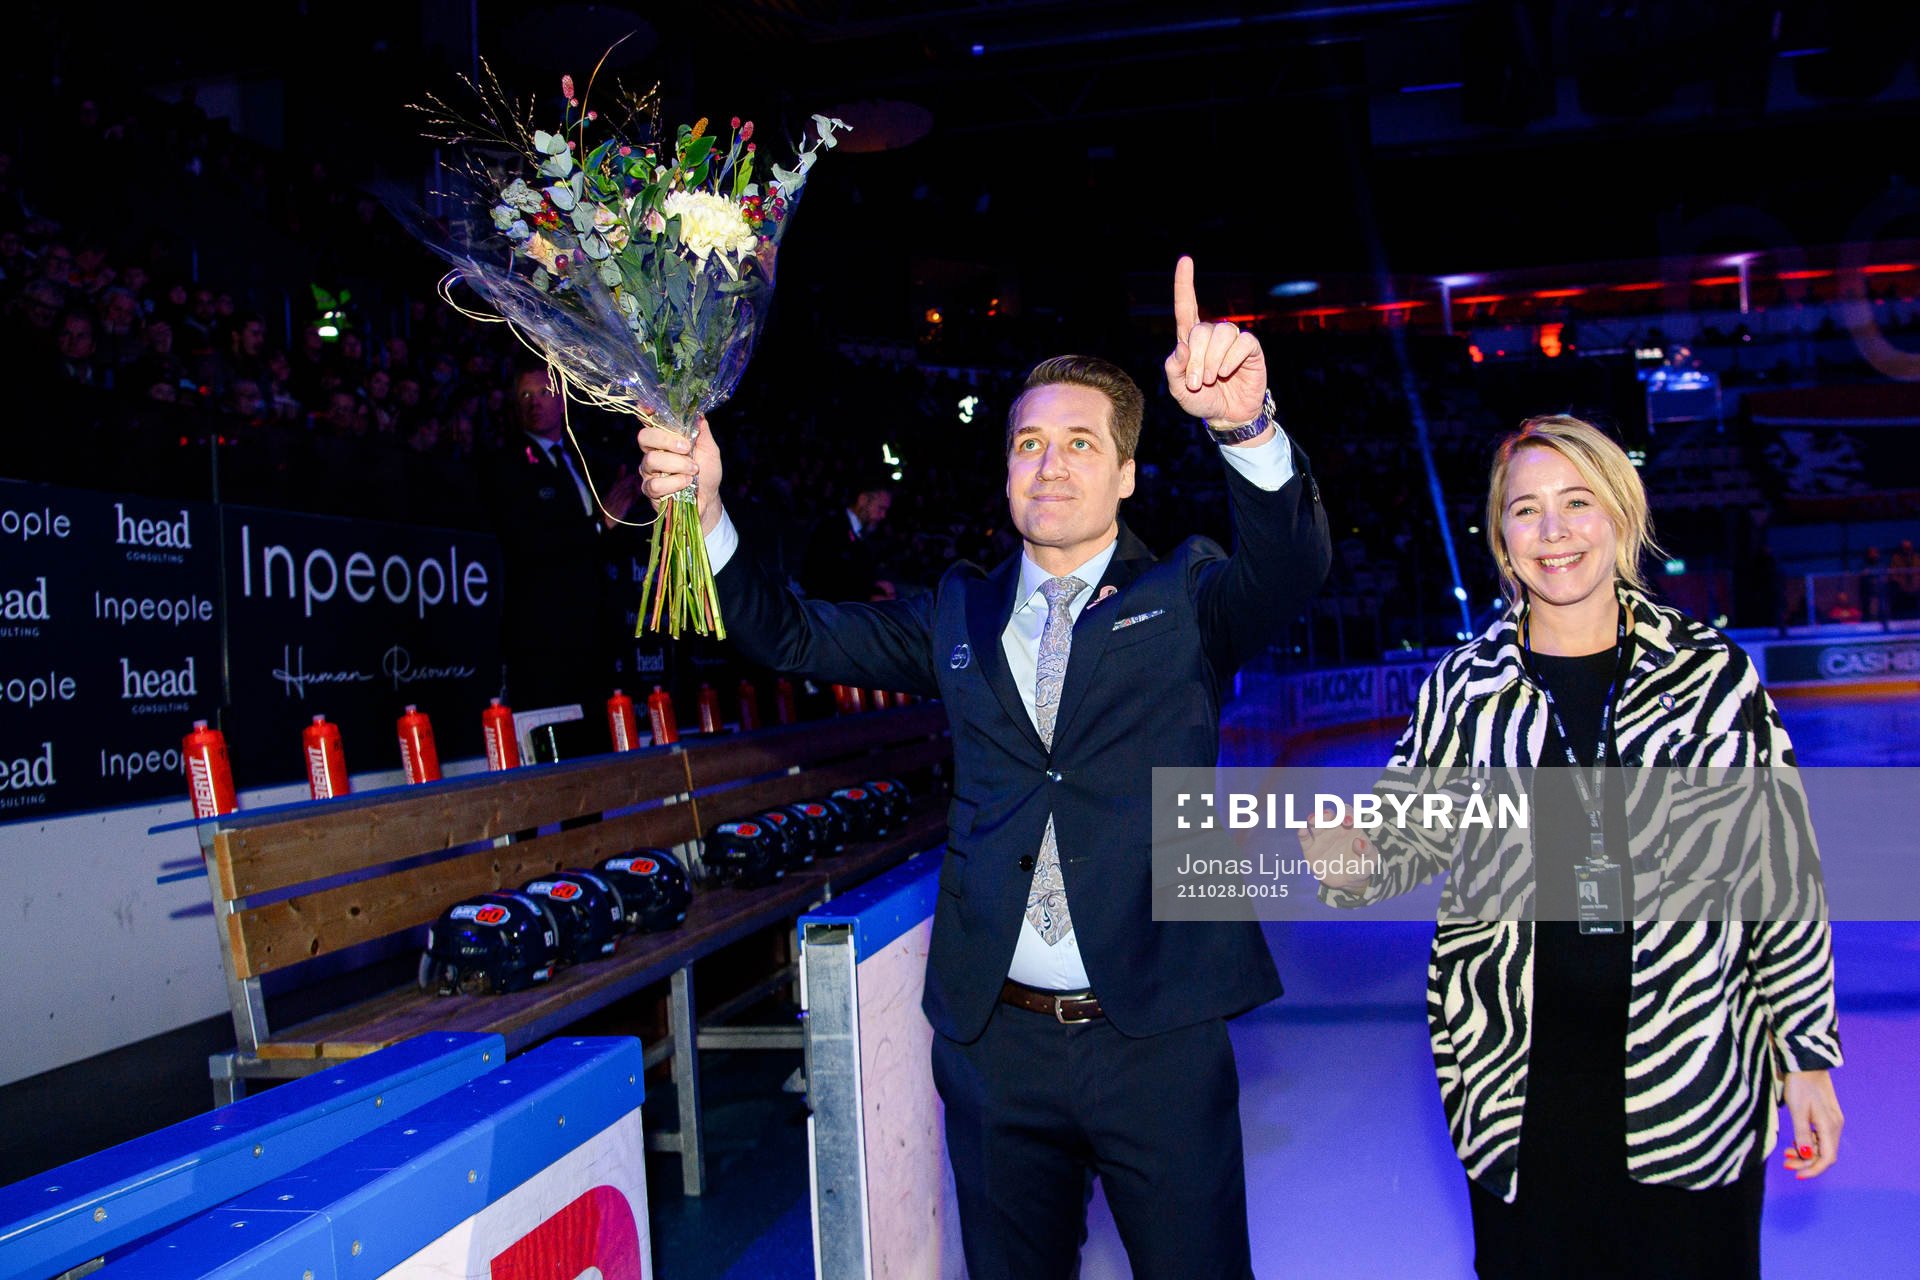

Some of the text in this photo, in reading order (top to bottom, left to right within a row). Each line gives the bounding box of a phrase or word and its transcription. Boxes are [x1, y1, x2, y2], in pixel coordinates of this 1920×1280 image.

[114, 503, 192, 549] head
[126, 552, 184, 563] CONSULTING
[242, 525, 488, 618] Inpeople
[96, 590, 213, 627] Inpeople
[120, 656, 198, 698] head
[272, 645, 476, 698] Human Resource
[131, 702, 190, 715] CONSULTING
